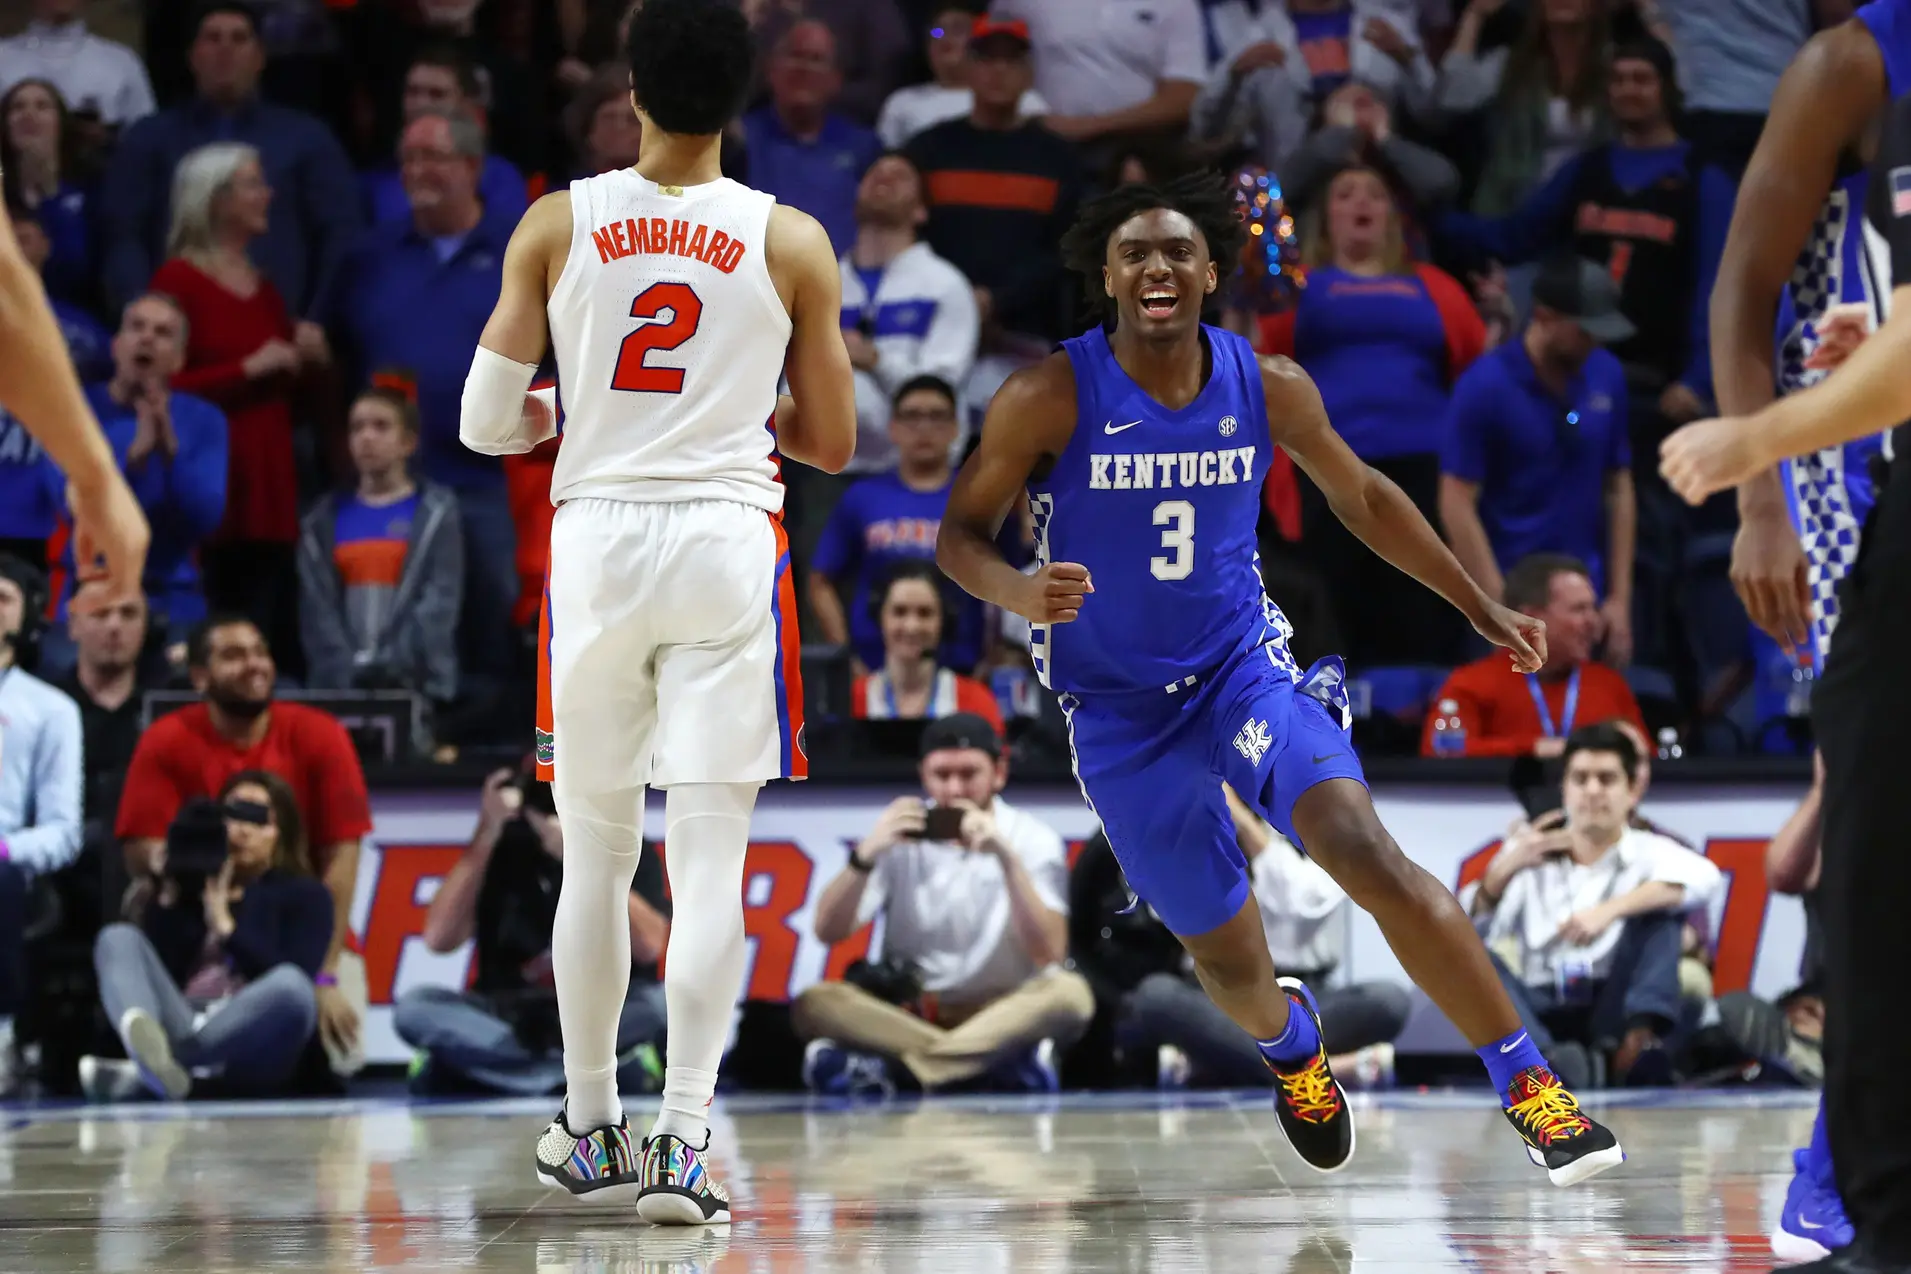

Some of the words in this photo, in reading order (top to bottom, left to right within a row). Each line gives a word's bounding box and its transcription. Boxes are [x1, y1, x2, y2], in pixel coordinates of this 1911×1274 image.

[591, 217, 746, 274] NEMBHARD
[610, 281, 703, 394] 2
[1220, 417, 1236, 436] SEC
[1089, 446, 1256, 490] KENTUCKY
[1150, 499, 1196, 581] 3
